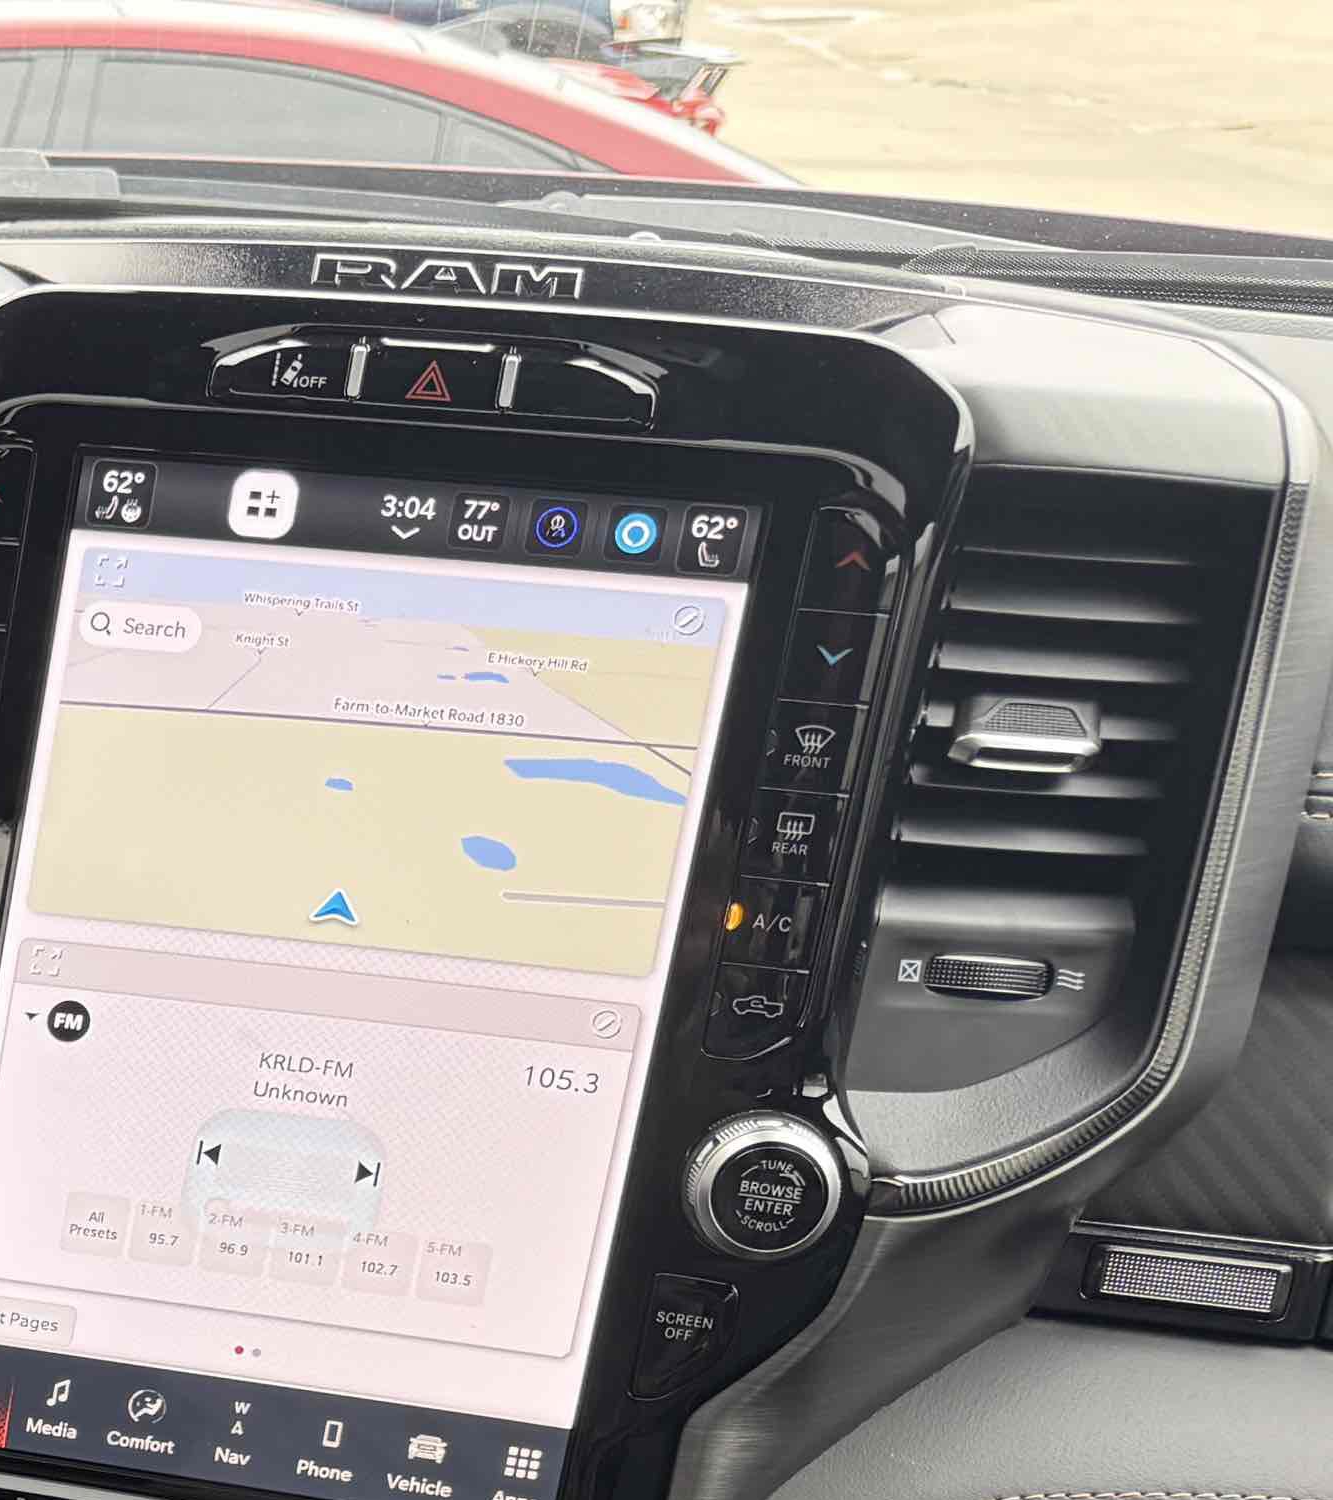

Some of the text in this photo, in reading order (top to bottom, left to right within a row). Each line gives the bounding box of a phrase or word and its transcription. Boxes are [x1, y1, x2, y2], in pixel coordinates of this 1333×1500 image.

[310, 253, 584, 299] RAM
[298, 375, 328, 389] OFF
[102, 470, 146, 495] 62°
[380, 494, 437, 520] 3:04
[464, 499, 501, 521] 77°
[457, 523, 499, 543] OUT
[690, 514, 739, 541] 62°
[244, 592, 359, 613] Whispering Trails St
[122, 616, 187, 639] Search
[234, 632, 291, 651] Knight St
[487, 652, 589, 672] E Hickory Hill Rd
[333, 697, 525, 728] Farm-to-Market Road 1830
[782, 753, 833, 770] FRONT
[770, 840, 809, 857] REAR
[751, 912, 793, 934] A/C
[53, 1012, 83, 1032] FM
[258, 1051, 355, 1079] KRLD-FM
[524, 1065, 600, 1094] 105.3
[252, 1080, 349, 1108] Unknown
[760, 1159, 795, 1175] TUNE
[739, 1179, 804, 1201] BROWSE
[139, 1203, 174, 1221] 1-FM
[743, 1198, 794, 1217] ENTER
[88, 1210, 106, 1226] All
[207, 1212, 244, 1229] 2-FM
[739, 1214, 788, 1234] SCROLL
[68, 1223, 119, 1242] Presets
[147, 1231, 183, 1248] 95.7
[279, 1221, 316, 1238] 3-FM
[351, 1231, 389, 1248] 4-FM
[217, 1241, 250, 1257] 96.9
[286, 1250, 325, 1268] 101.1
[425, 1240, 463, 1258] 5-FM
[359, 1259, 399, 1277] 102.7
[433, 1269, 473, 1288] 103.5
[9, 1312, 60, 1334] Pages
[655, 1310, 715, 1330] SCREEN
[664, 1326, 694, 1342] OFF
[24, 1416, 78, 1440] Media
[105, 1429, 176, 1455] Comfort
[213, 1446, 252, 1467] Nav
[295, 1457, 355, 1483] Phone
[385, 1472, 454, 1500] Vehicle
